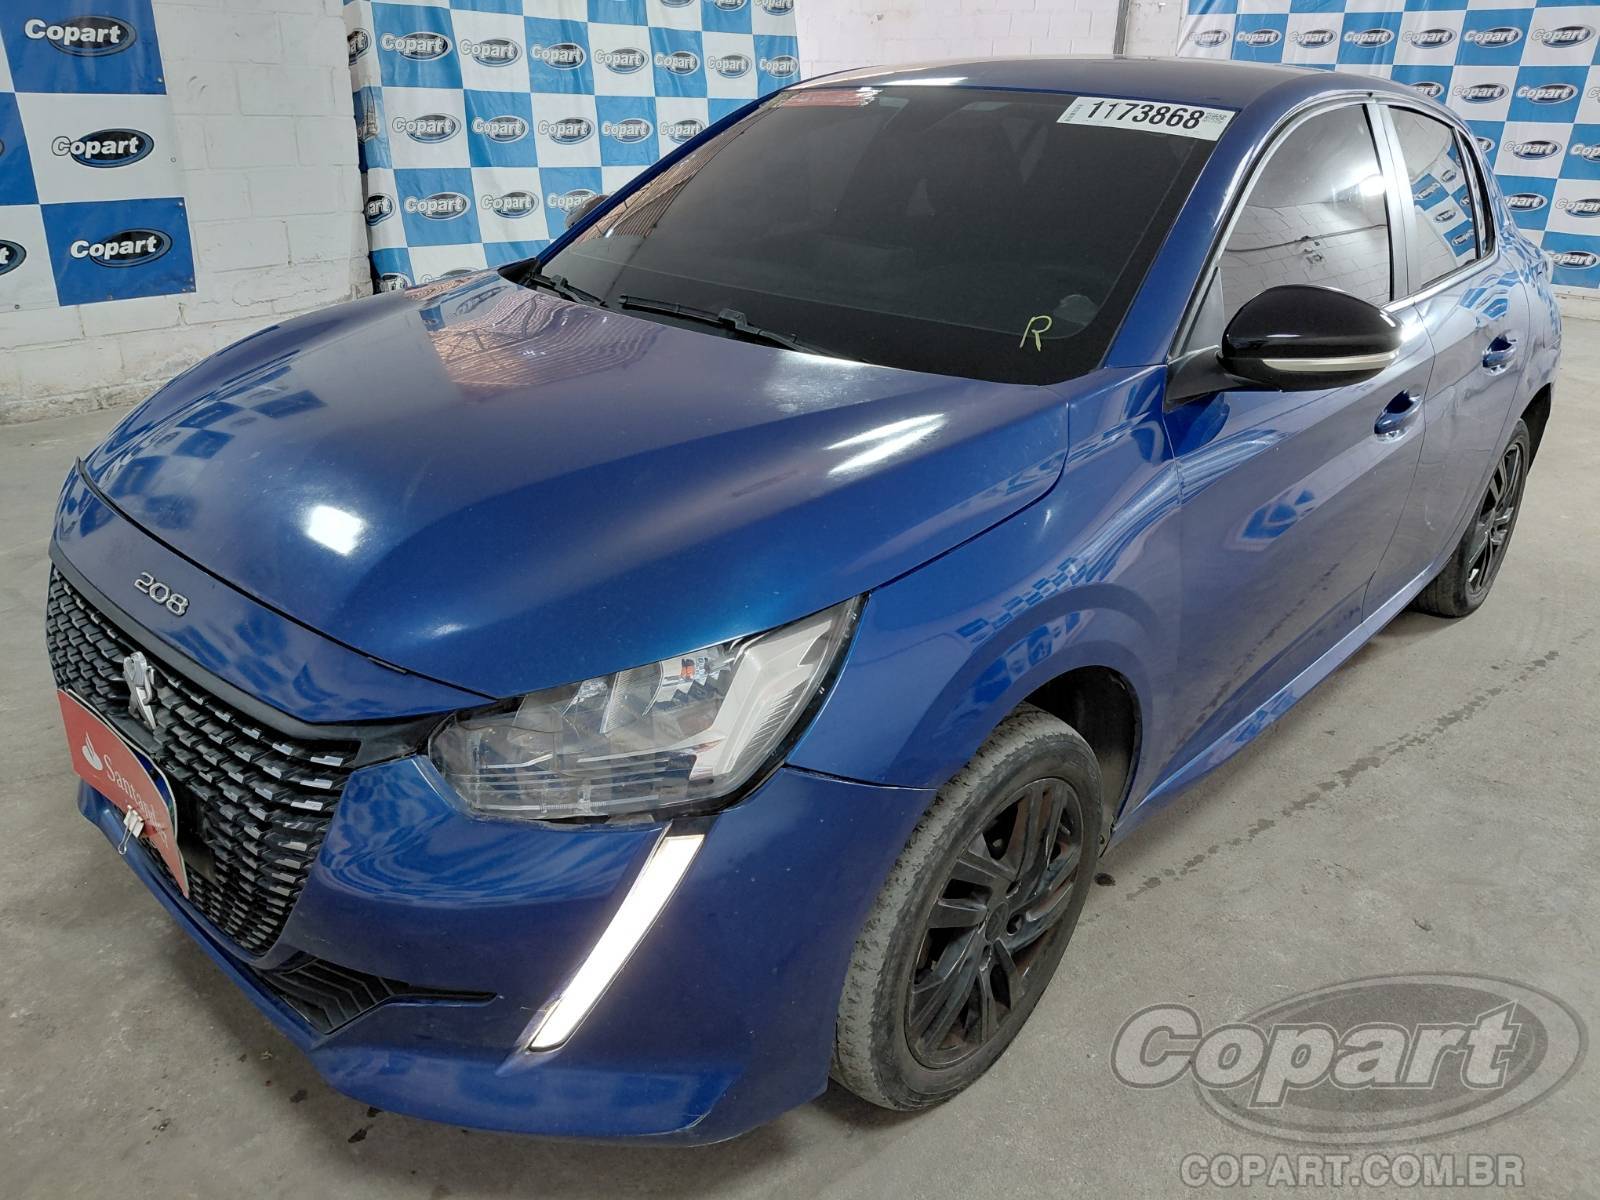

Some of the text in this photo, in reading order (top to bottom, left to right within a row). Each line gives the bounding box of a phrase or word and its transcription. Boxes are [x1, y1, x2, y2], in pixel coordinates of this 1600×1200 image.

[24, 18, 121, 45] Copart
[1236, 31, 1277, 44] Copart
[1289, 31, 1330, 44] Copart
[1344, 30, 1391, 45] Copart
[1403, 31, 1449, 43] Copart
[1465, 29, 1518, 43] Copart
[1531, 28, 1588, 43] Copart
[381, 32, 444, 54] Copart
[460, 39, 516, 59] Copart
[531, 44, 582, 62] Copart
[595, 50, 642, 69] Copart
[655, 53, 696, 70] Copart
[707, 56, 747, 71] Copart
[760, 58, 797, 73] Copart
[1453, 85, 1501, 99] Copart
[1518, 86, 1570, 100] Copart
[1087, 100, 1205, 130] 1173868
[392, 117, 455, 136] Copart
[472, 117, 522, 137] Copart
[538, 120, 587, 137] Copart
[603, 123, 648, 139] Copart
[52, 135, 139, 158] Copart
[1503, 141, 1557, 156] Copart
[404, 196, 465, 216] Copart
[480, 194, 533, 210] Copart
[71, 234, 157, 259] Copart
[1020, 315, 1052, 352] R
[134, 572, 189, 616] 208
